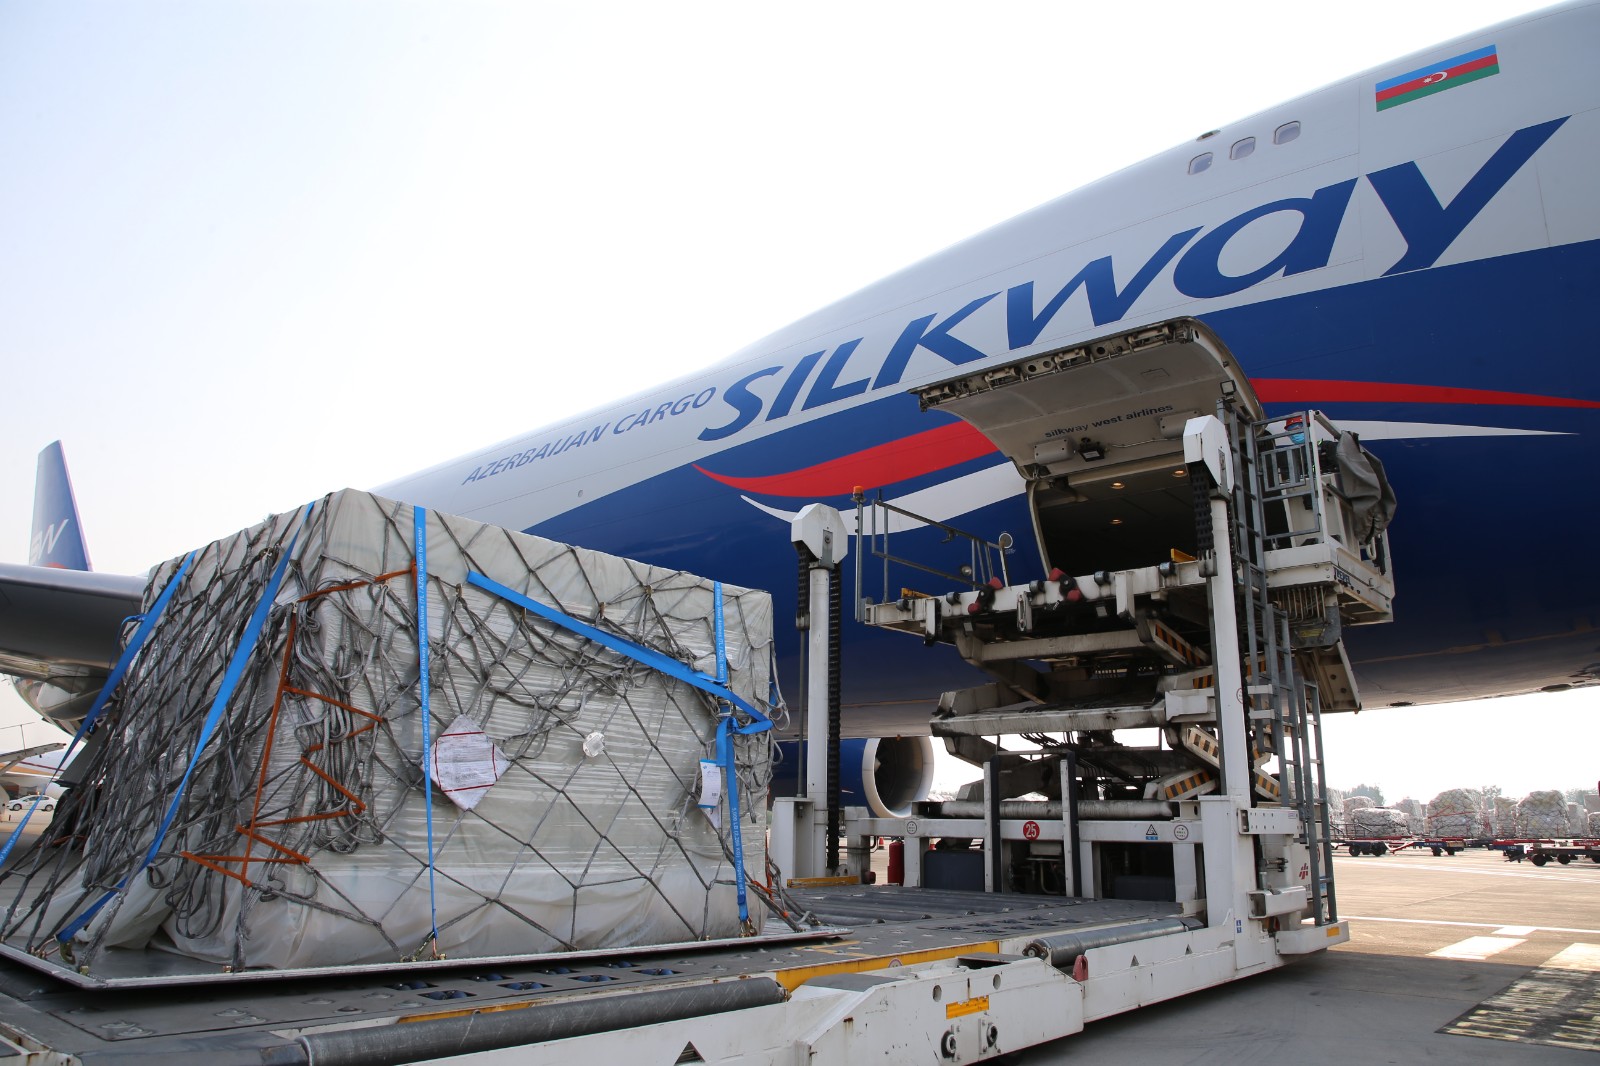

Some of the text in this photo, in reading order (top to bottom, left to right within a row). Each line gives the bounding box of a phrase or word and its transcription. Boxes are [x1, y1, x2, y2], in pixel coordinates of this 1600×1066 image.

[461, 386, 717, 486] AZERBAIJAN CARGO
[1045, 404, 1174, 439] silkway west airlines
[1025, 824, 1037, 838] 25
